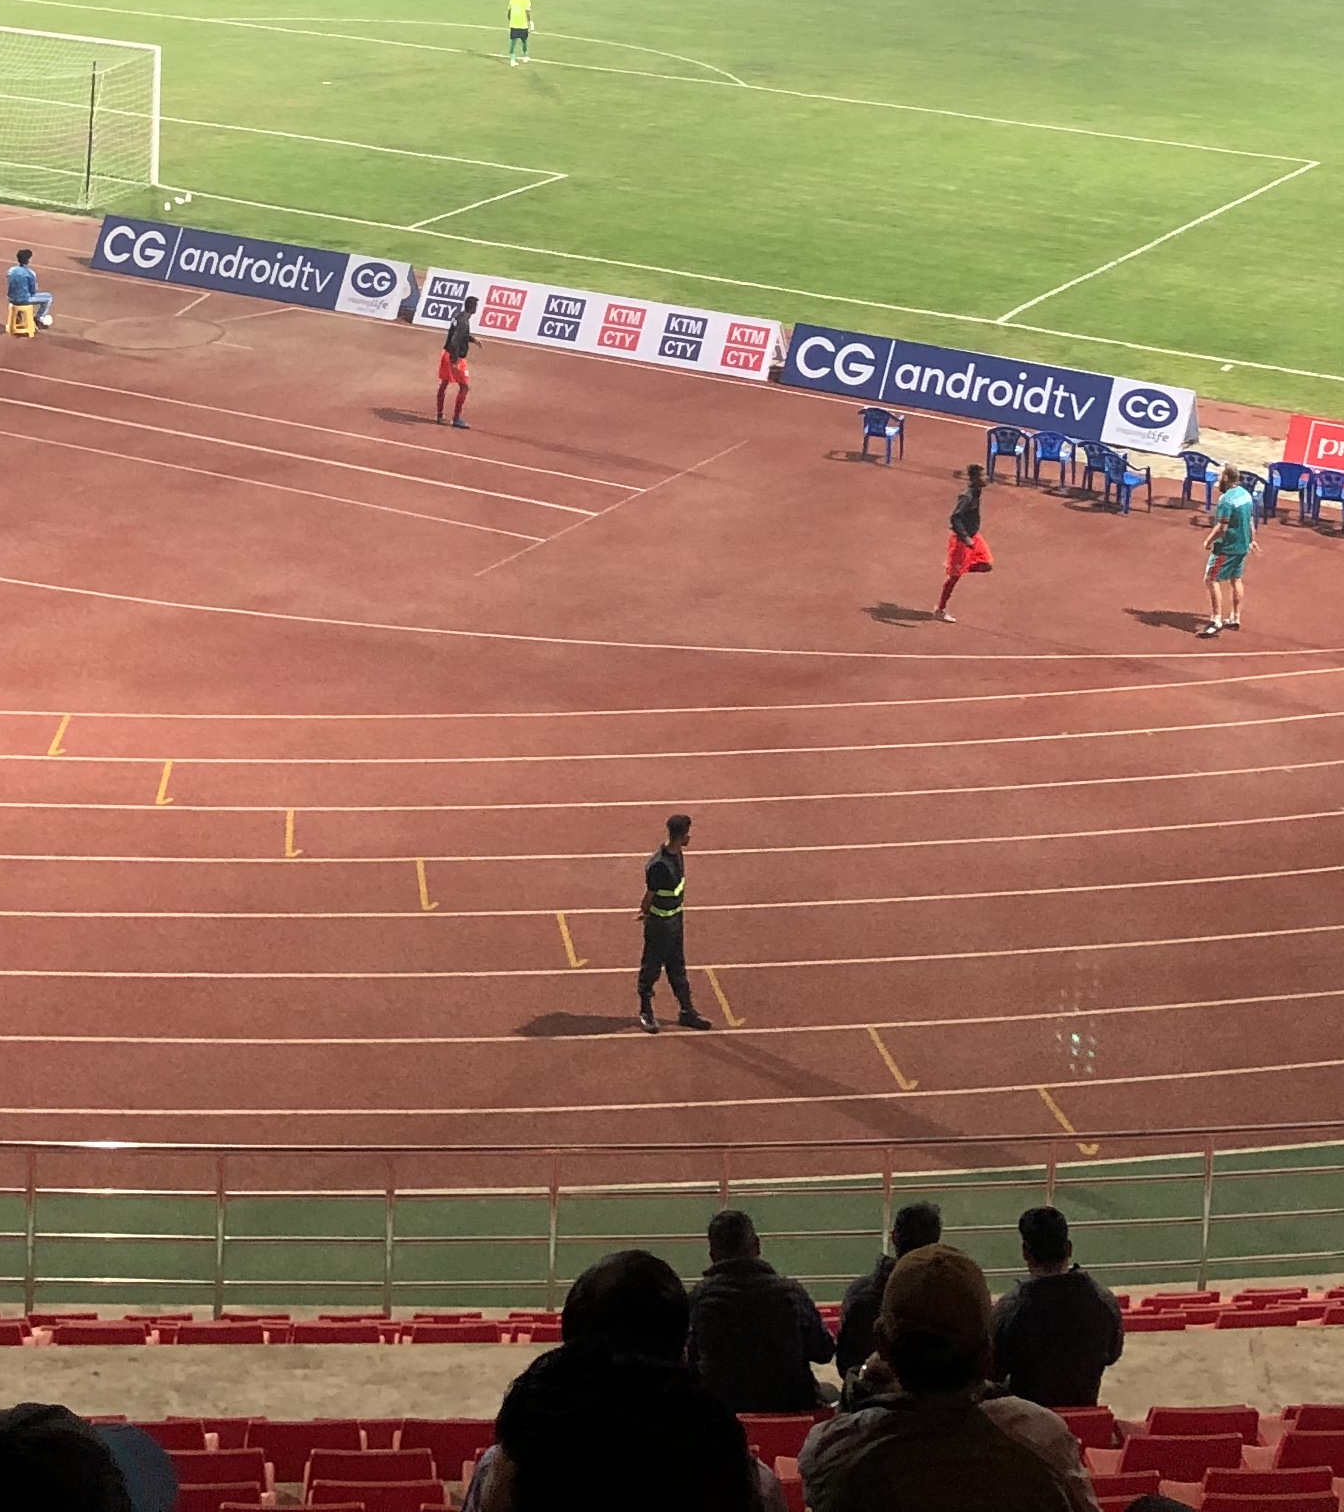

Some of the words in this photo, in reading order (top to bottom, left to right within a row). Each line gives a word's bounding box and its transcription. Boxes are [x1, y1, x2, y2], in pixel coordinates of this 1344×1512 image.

[103, 225, 167, 269] CG
[179, 245, 335, 294] androidtv
[356, 268, 392, 292] CG
[432, 278, 467, 299] KTM
[490, 287, 524, 308] KTM
[548, 296, 583, 317] KTM
[427, 301, 458, 320] CTY
[484, 310, 518, 331] CTY
[608, 306, 643, 327] KTM
[543, 319, 577, 341] CTY
[669, 315, 705, 336] KTM
[730, 326, 766, 345] KTM
[602, 329, 636, 350] CTY
[663, 337, 697, 360] CTY
[726, 350, 760, 368] CTY
[795, 335, 876, 386] CG
[894, 361, 1096, 422] androidtv
[1125, 395, 1171, 421] CG
